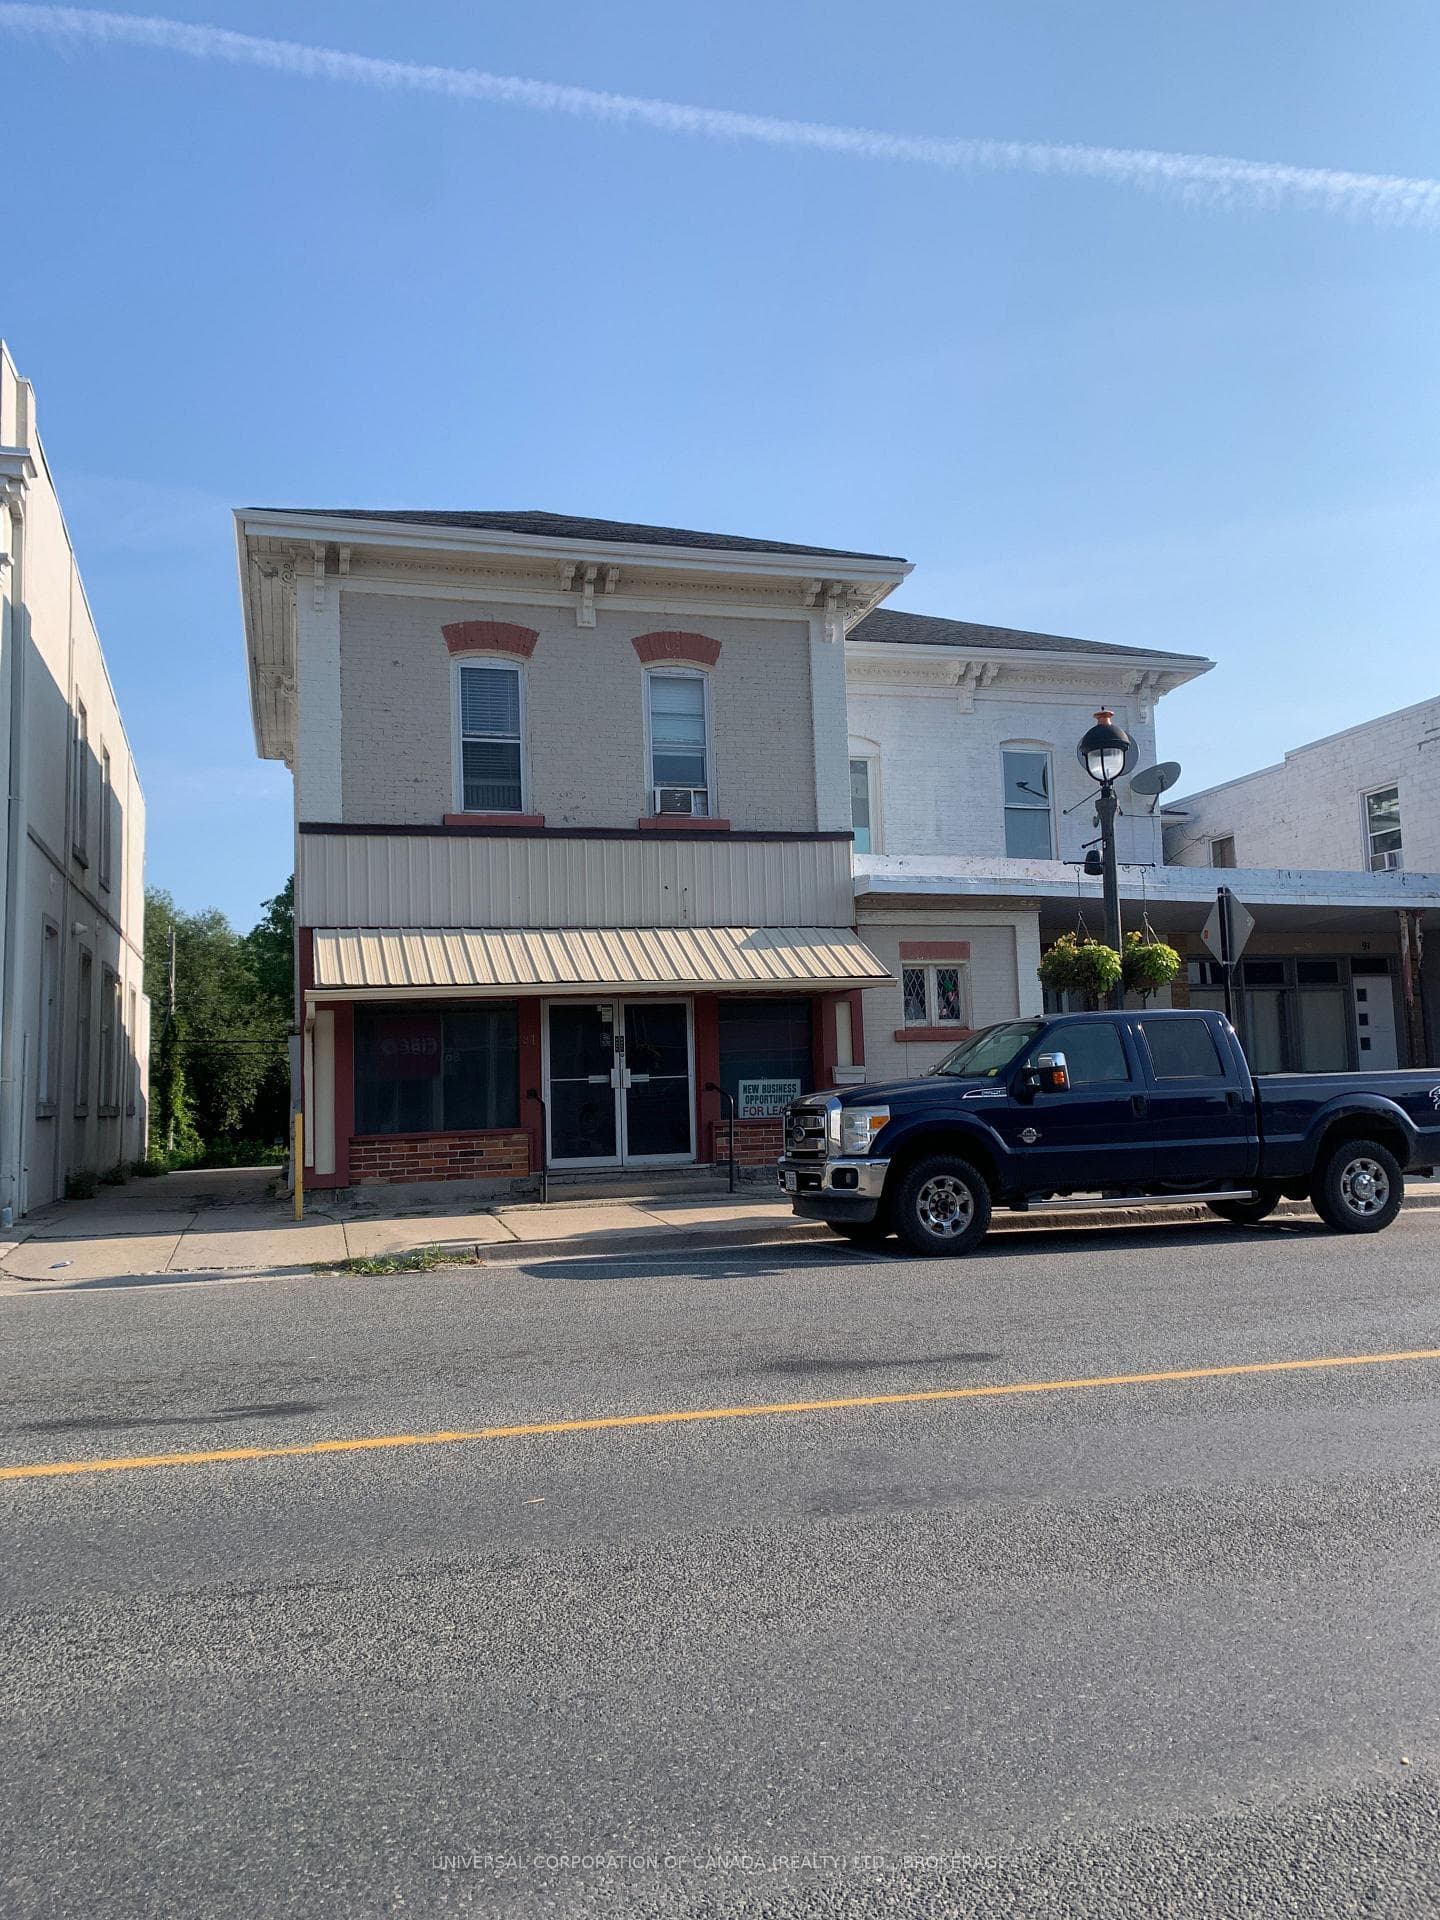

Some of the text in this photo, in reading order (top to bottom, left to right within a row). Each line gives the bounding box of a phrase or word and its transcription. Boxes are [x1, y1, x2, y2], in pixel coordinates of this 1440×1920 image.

[743, 1083, 797, 1094] NEW BUSINESS
[742, 1106, 786, 1116] FOR LEA
